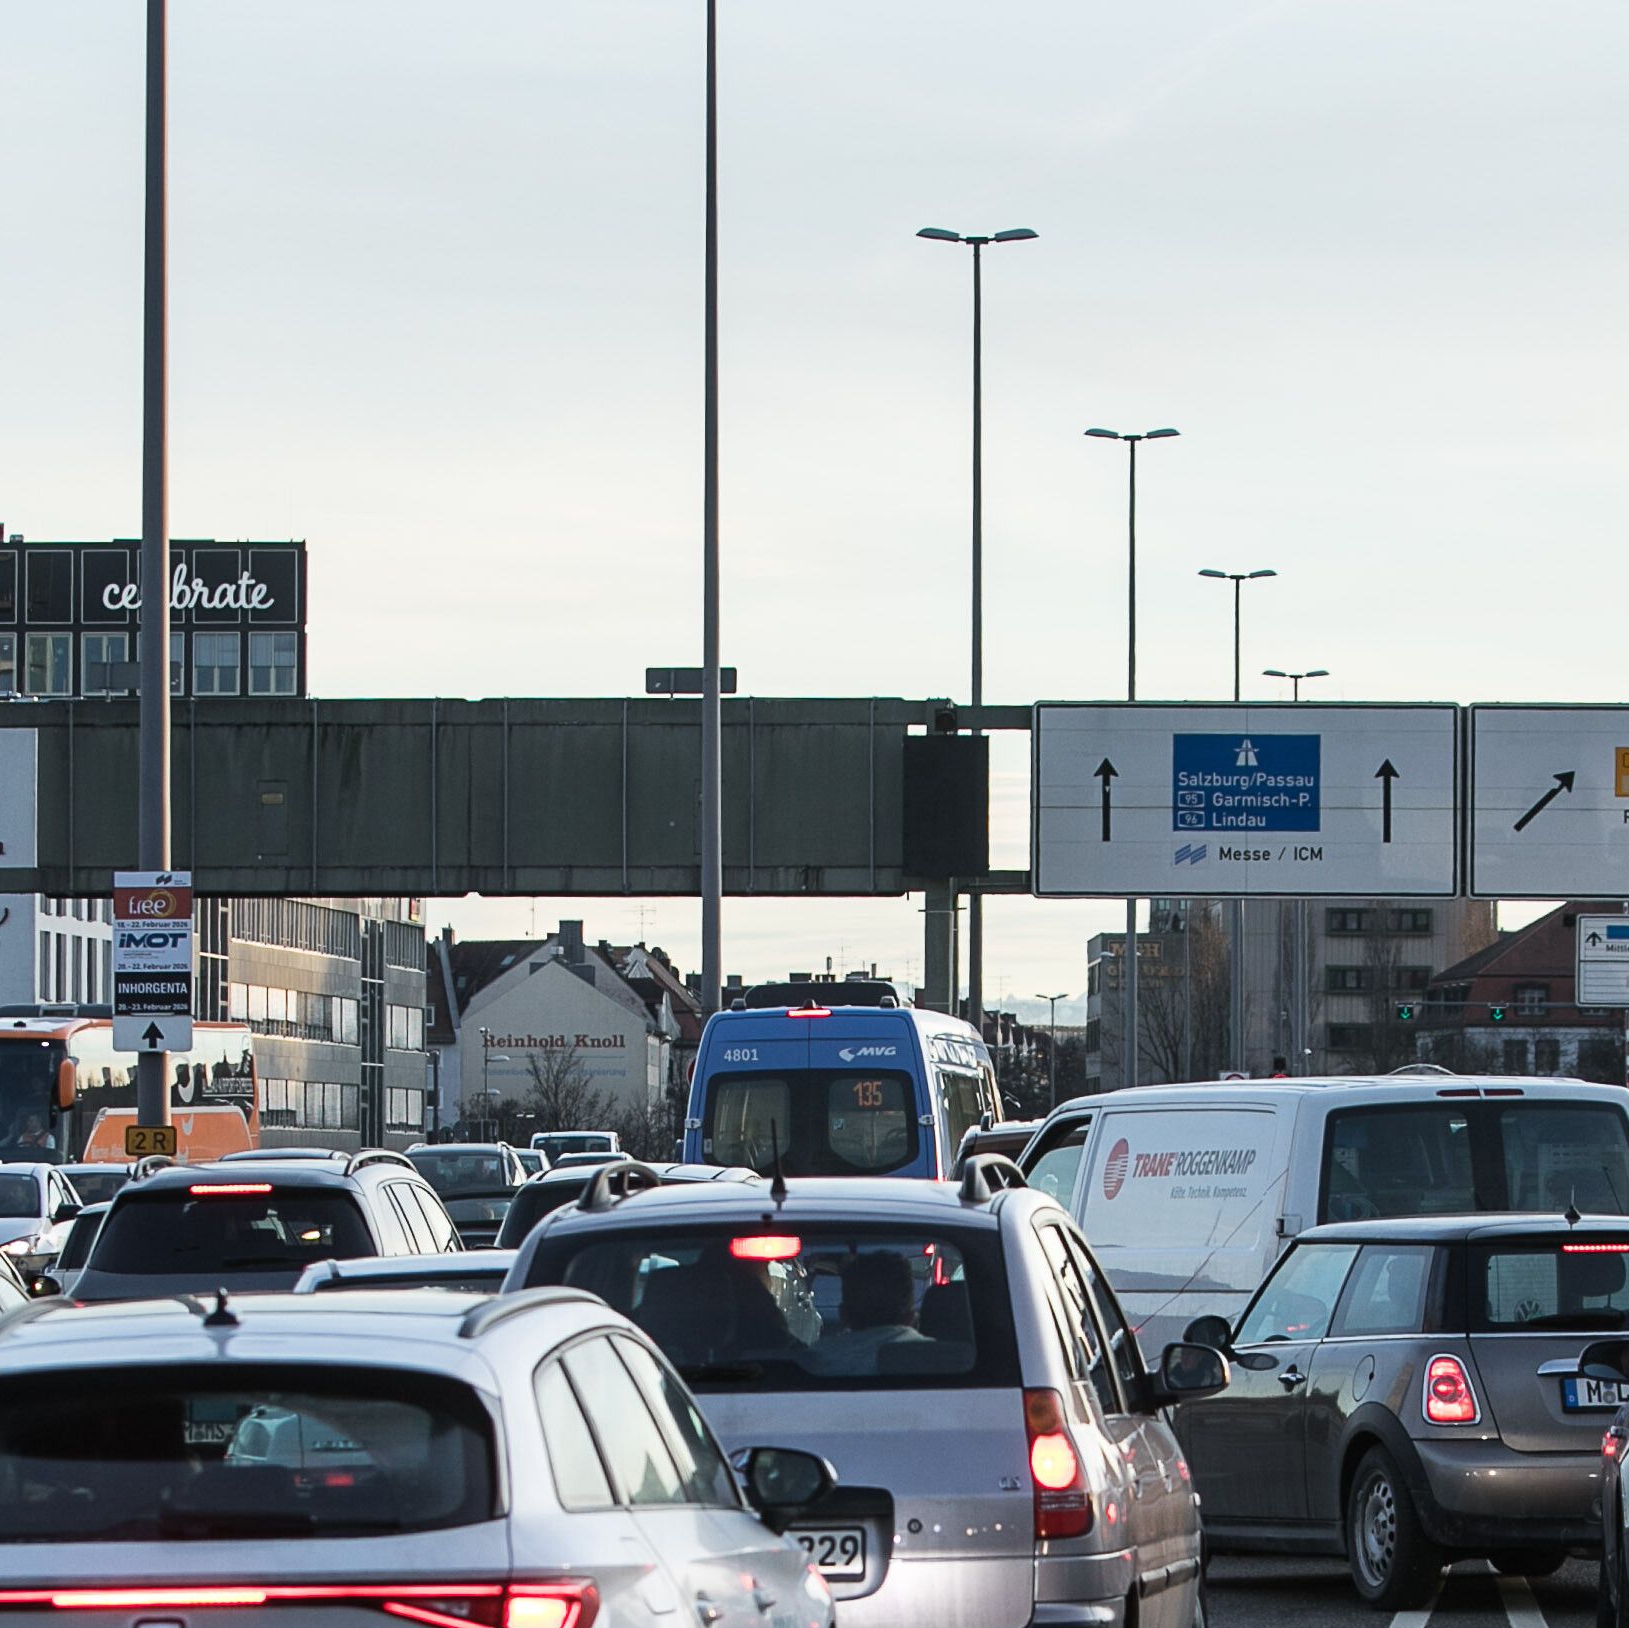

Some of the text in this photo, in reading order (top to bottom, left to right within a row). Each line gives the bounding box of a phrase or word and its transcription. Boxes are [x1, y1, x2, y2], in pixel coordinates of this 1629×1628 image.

[103, 563, 274, 610] cebrate
[1178, 772, 1314, 790] Salzburg/Passau
[1185, 792, 1312, 807] 95 Garmisch-P.
[1185, 812, 1266, 827] 96 Lindau
[1219, 847, 1271, 861] Messe
[1294, 847, 1323, 861] ICM
[118, 933, 187, 948] iMOT
[118, 983, 188, 994] INHORGENTA
[143, 1003, 172, 1011] Februar
[482, 1034, 626, 1048] Reinhold Knoll
[723, 1048, 760, 1062] 4801
[856, 1046, 897, 1057] MVG
[853, 1080, 883, 1107] 135
[135, 1132, 166, 1150] 2 R
[1132, 1149, 1257, 1178] TRANE ROGGENKAMP
[1586, 1380, 1602, 1403] M
